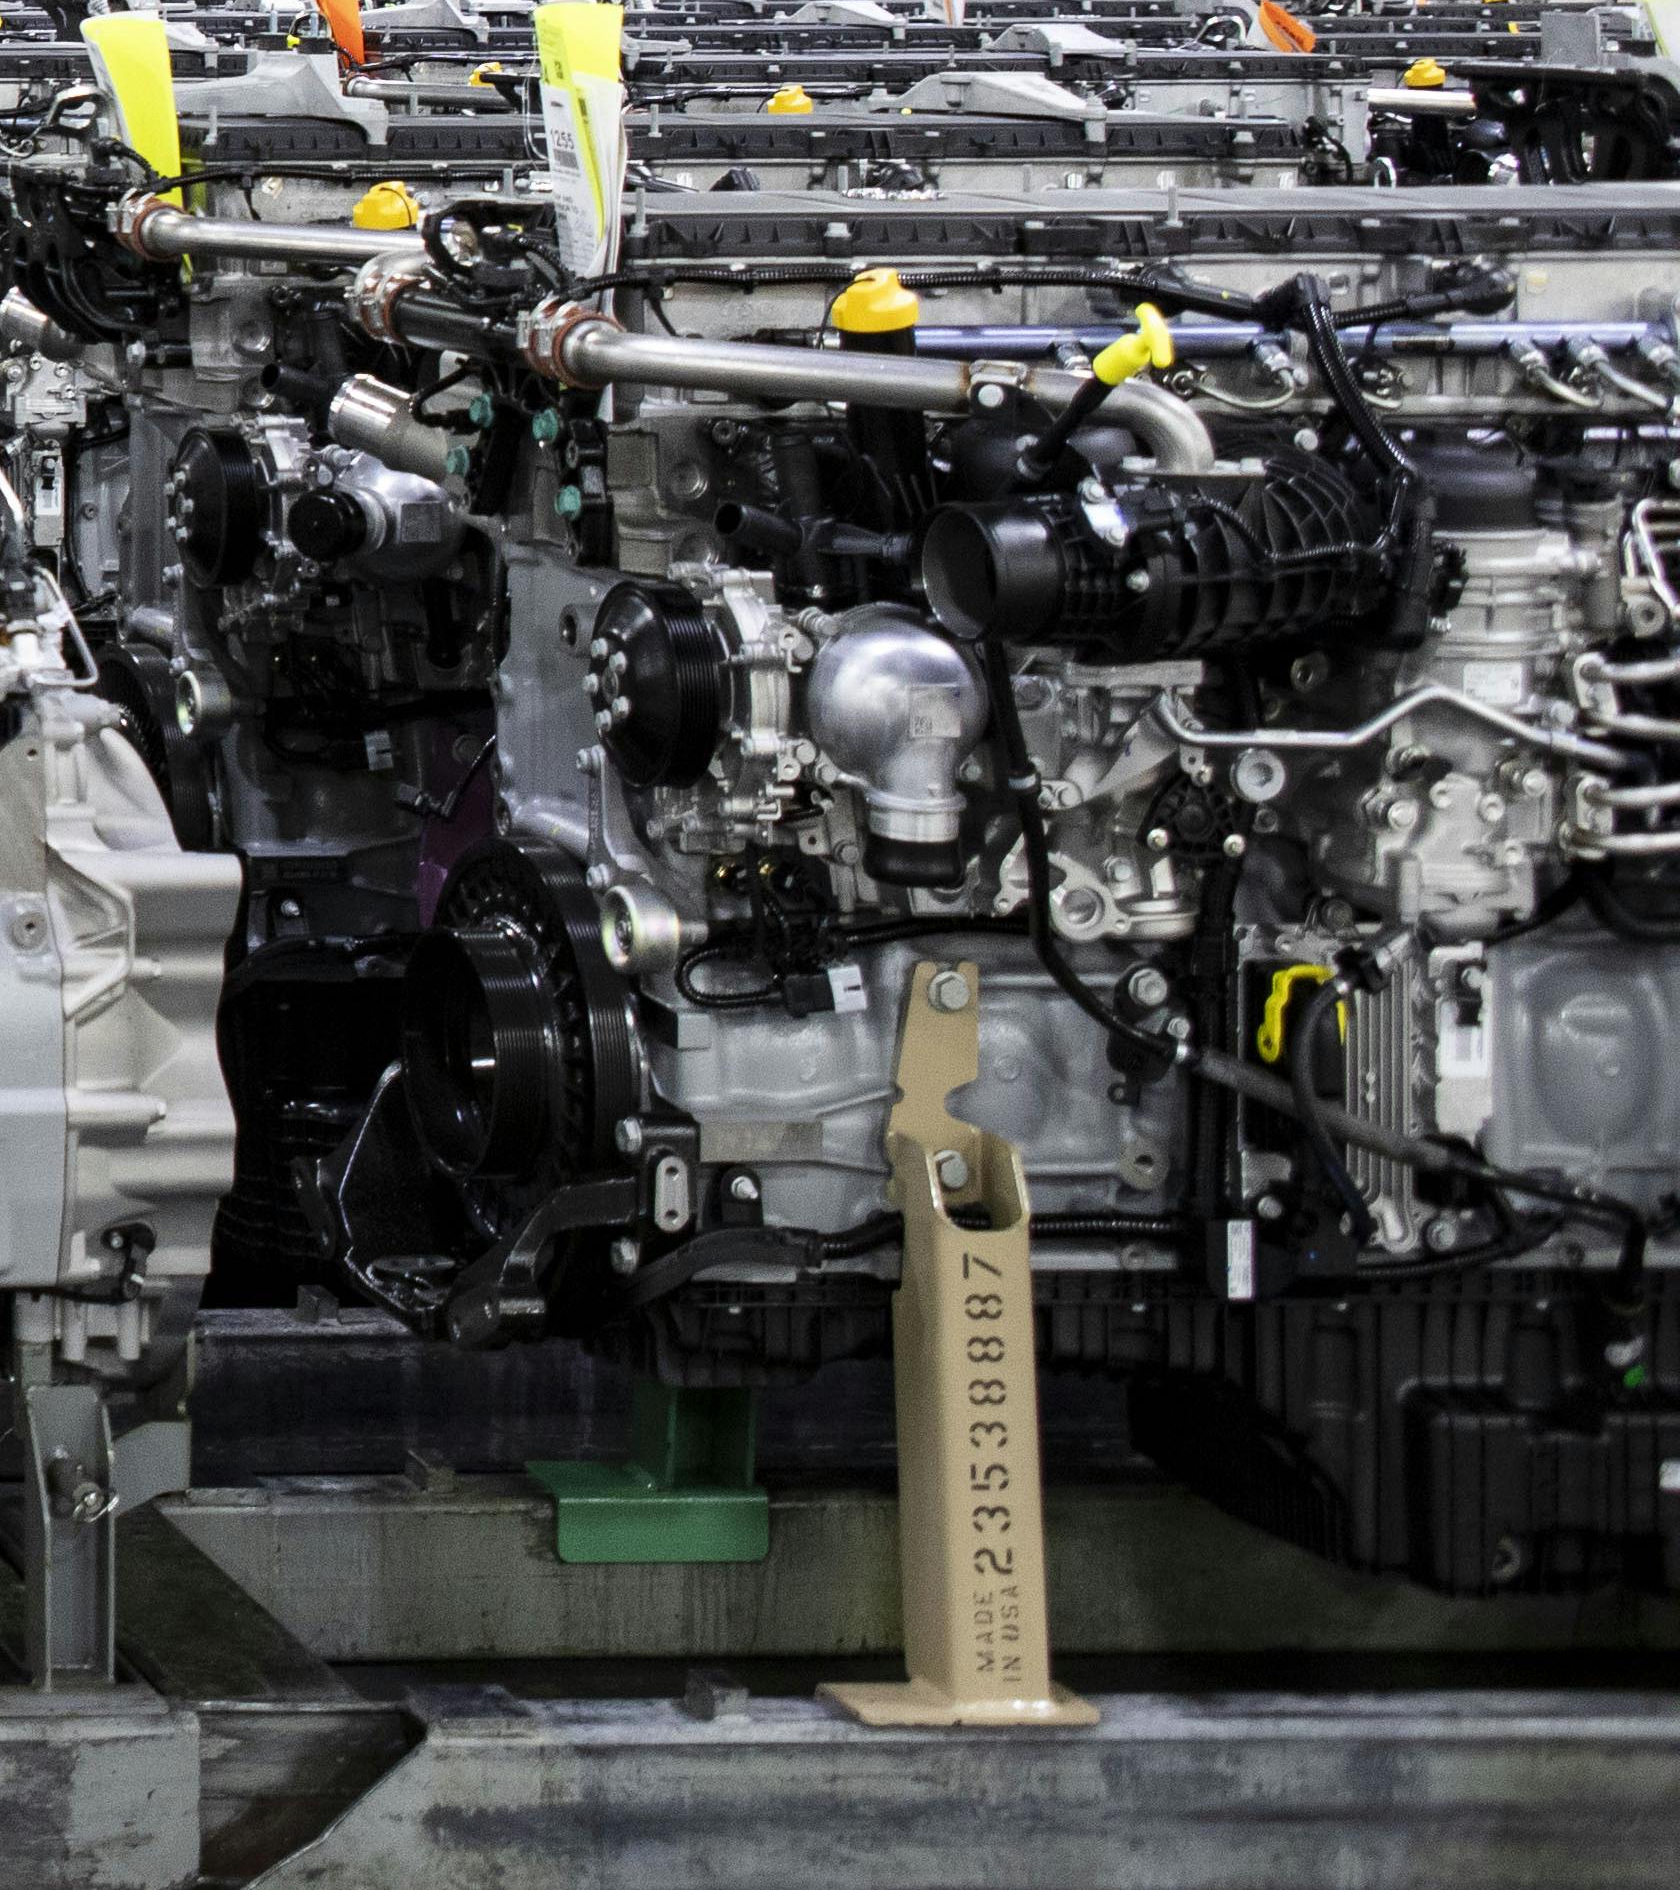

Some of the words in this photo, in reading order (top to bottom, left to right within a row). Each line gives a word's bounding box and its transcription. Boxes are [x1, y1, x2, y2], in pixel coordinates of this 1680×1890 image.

[962, 1253, 1013, 1575] 23538887
[973, 1591, 994, 1672] MADE
[1000, 1584, 1019, 1641] USA
[1001, 1656, 1021, 1683] IN
